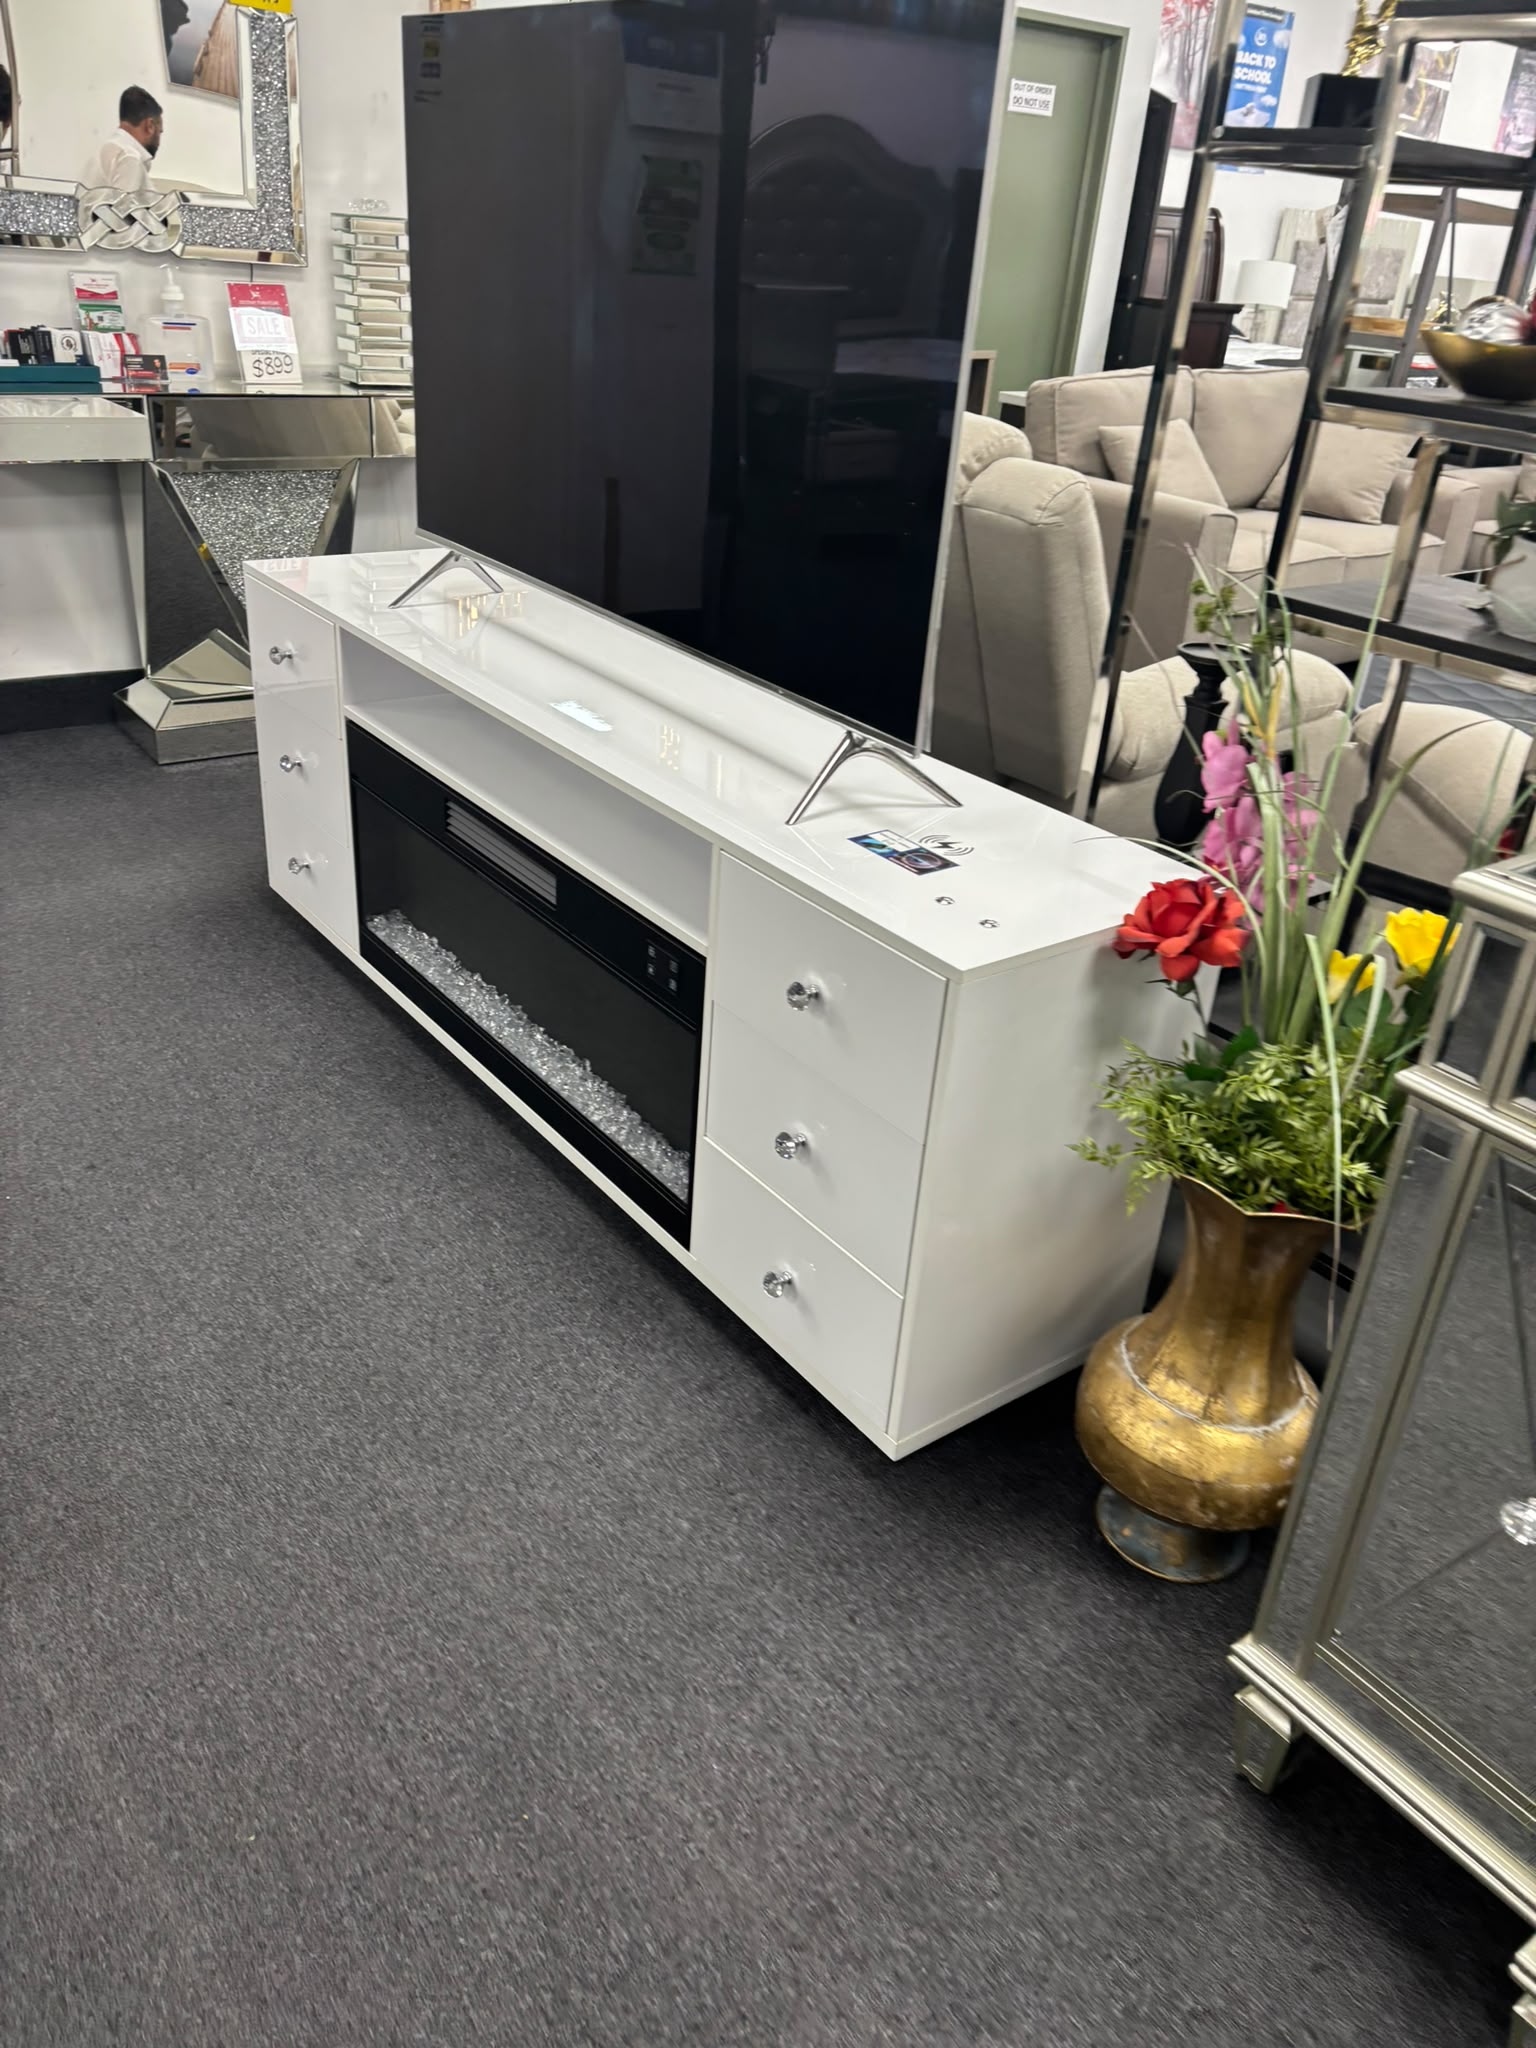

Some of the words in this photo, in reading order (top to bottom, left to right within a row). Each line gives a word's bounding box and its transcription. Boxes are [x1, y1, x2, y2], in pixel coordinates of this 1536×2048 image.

[1236, 51, 1264, 67] BACK
[1264, 55, 1277, 70] TO
[1234, 67, 1273, 85] SCHOOL
[1014, 83, 1026, 91] OUT
[1026, 84, 1034, 92] OF
[1035, 86, 1053, 95] ORDER
[1013, 96, 1024, 105] DO
[1024, 98, 1038, 107] NOT
[1039, 100, 1051, 109] USE
[247, 316, 282, 336] SALE
[252, 354, 293, 377] $899
